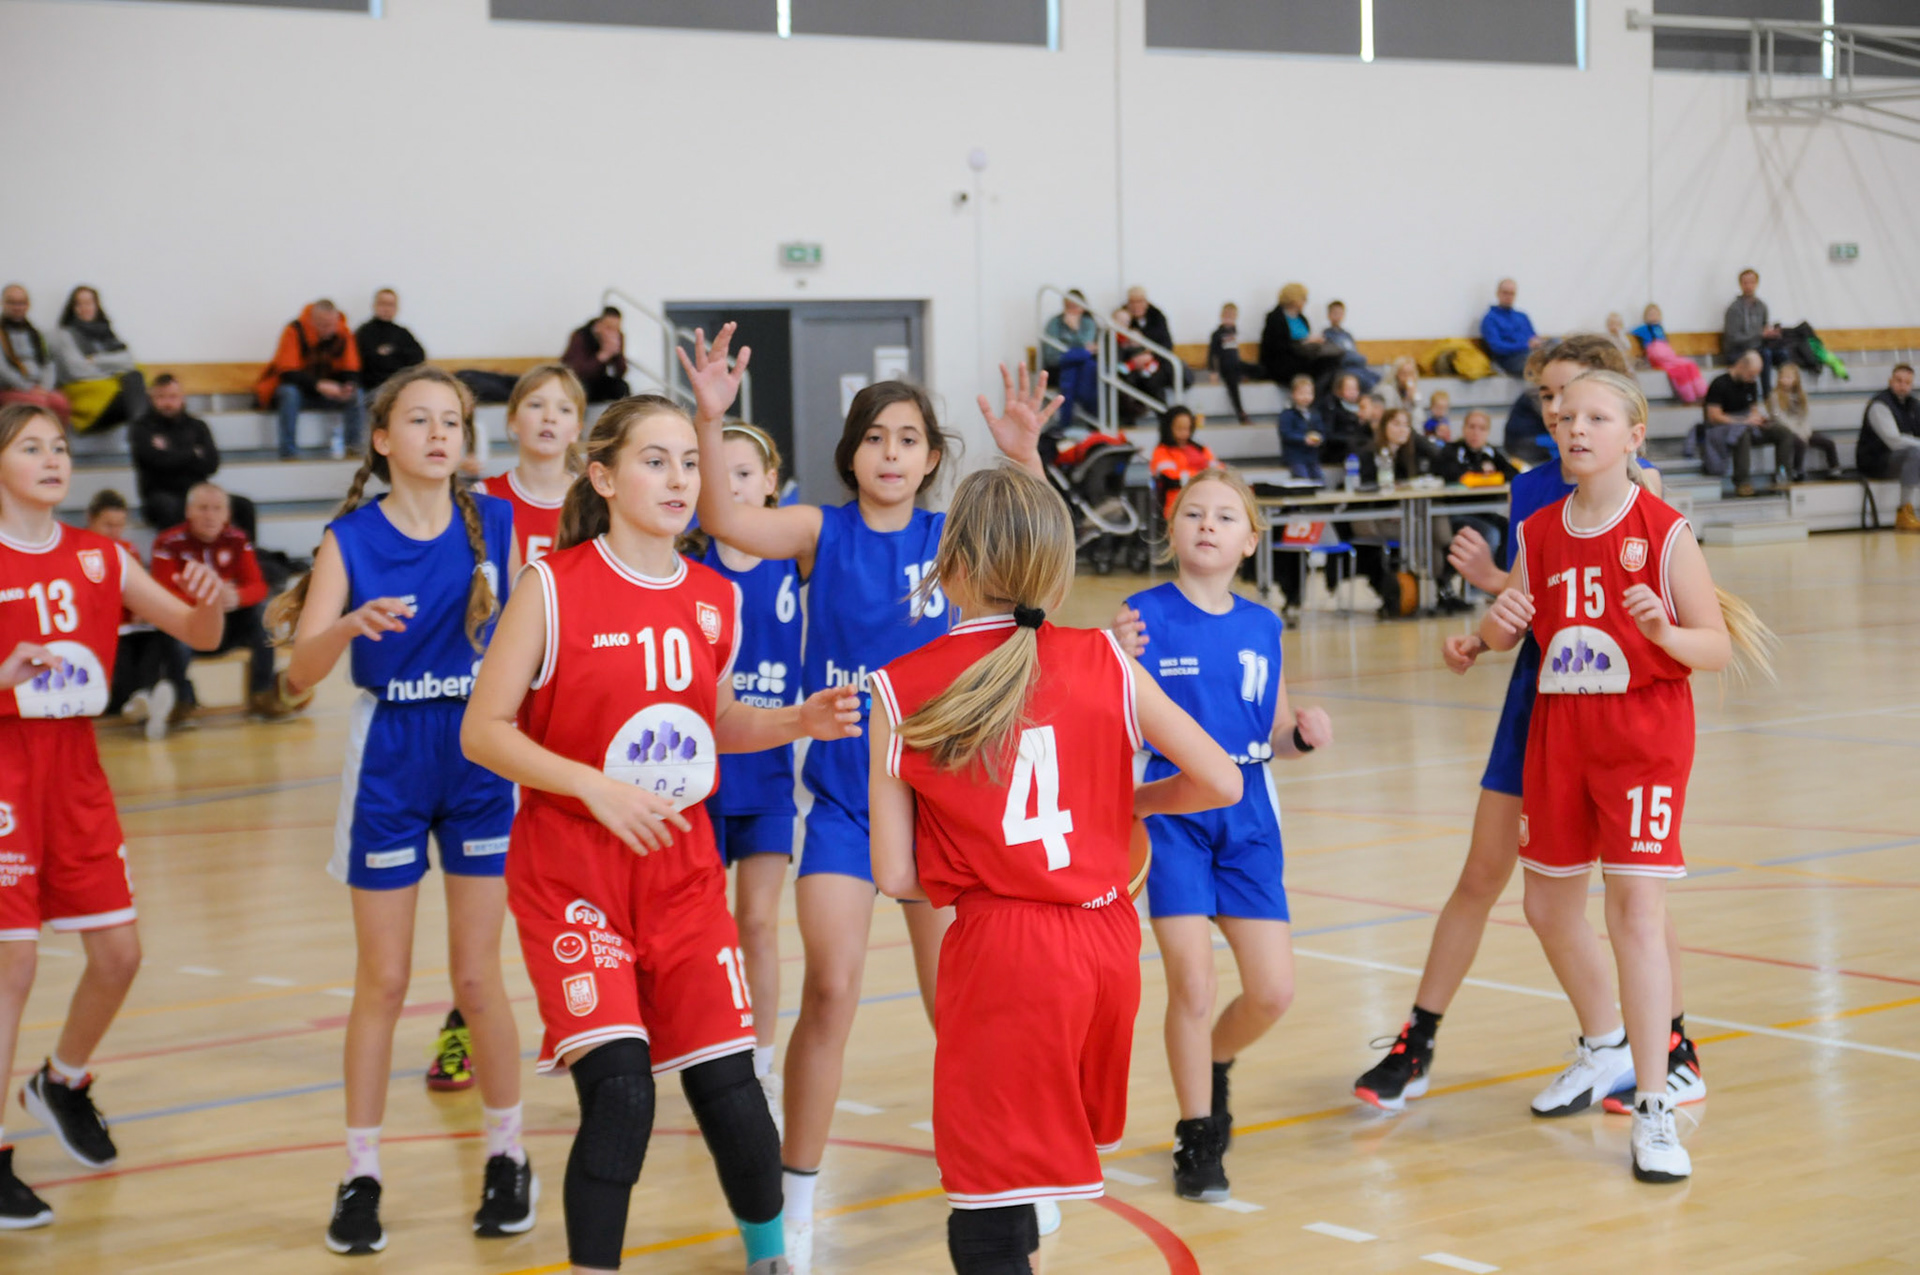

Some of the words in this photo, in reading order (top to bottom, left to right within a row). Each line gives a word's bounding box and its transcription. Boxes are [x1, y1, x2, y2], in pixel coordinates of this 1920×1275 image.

[0, 587, 24, 603] AKO
[28, 579, 78, 636] 13
[775, 575, 796, 624] 6
[1561, 566, 1606, 619] 15
[592, 632, 630, 649] JAKO
[636, 626, 692, 692] 10
[1238, 649, 1268, 707] 11
[1002, 725, 1074, 872] 4
[1627, 785, 1673, 841] 15
[1631, 840, 1663, 855] JAKO
[1080, 885, 1118, 910] om.pl
[574, 908, 599, 926] PZU
[588, 929, 622, 946] Dobra
[593, 955, 620, 969] PZU
